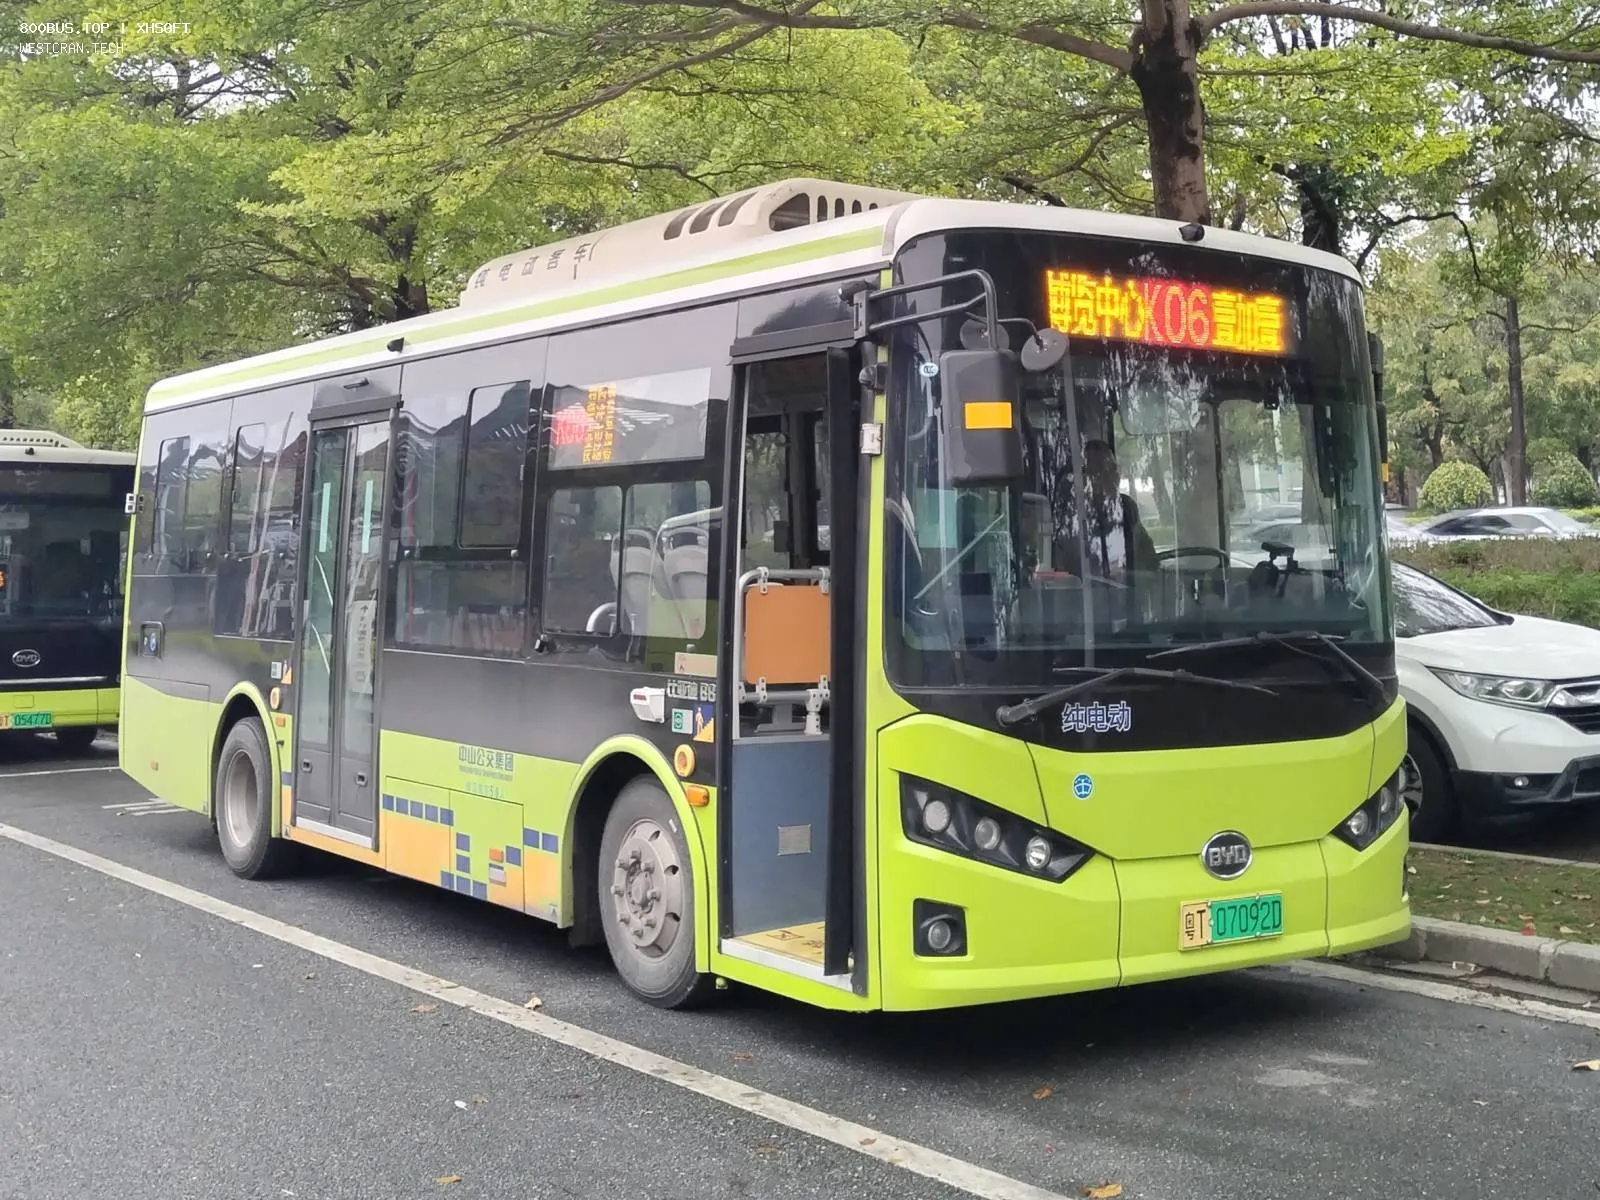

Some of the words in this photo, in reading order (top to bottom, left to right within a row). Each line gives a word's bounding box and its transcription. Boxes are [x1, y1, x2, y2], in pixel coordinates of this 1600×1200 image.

[1143, 281, 1210, 346] K06
[1061, 700, 1132, 733] 纯电动
[1208, 844, 1247, 867] BYD
[1216, 900, 1282, 936] 07092D
